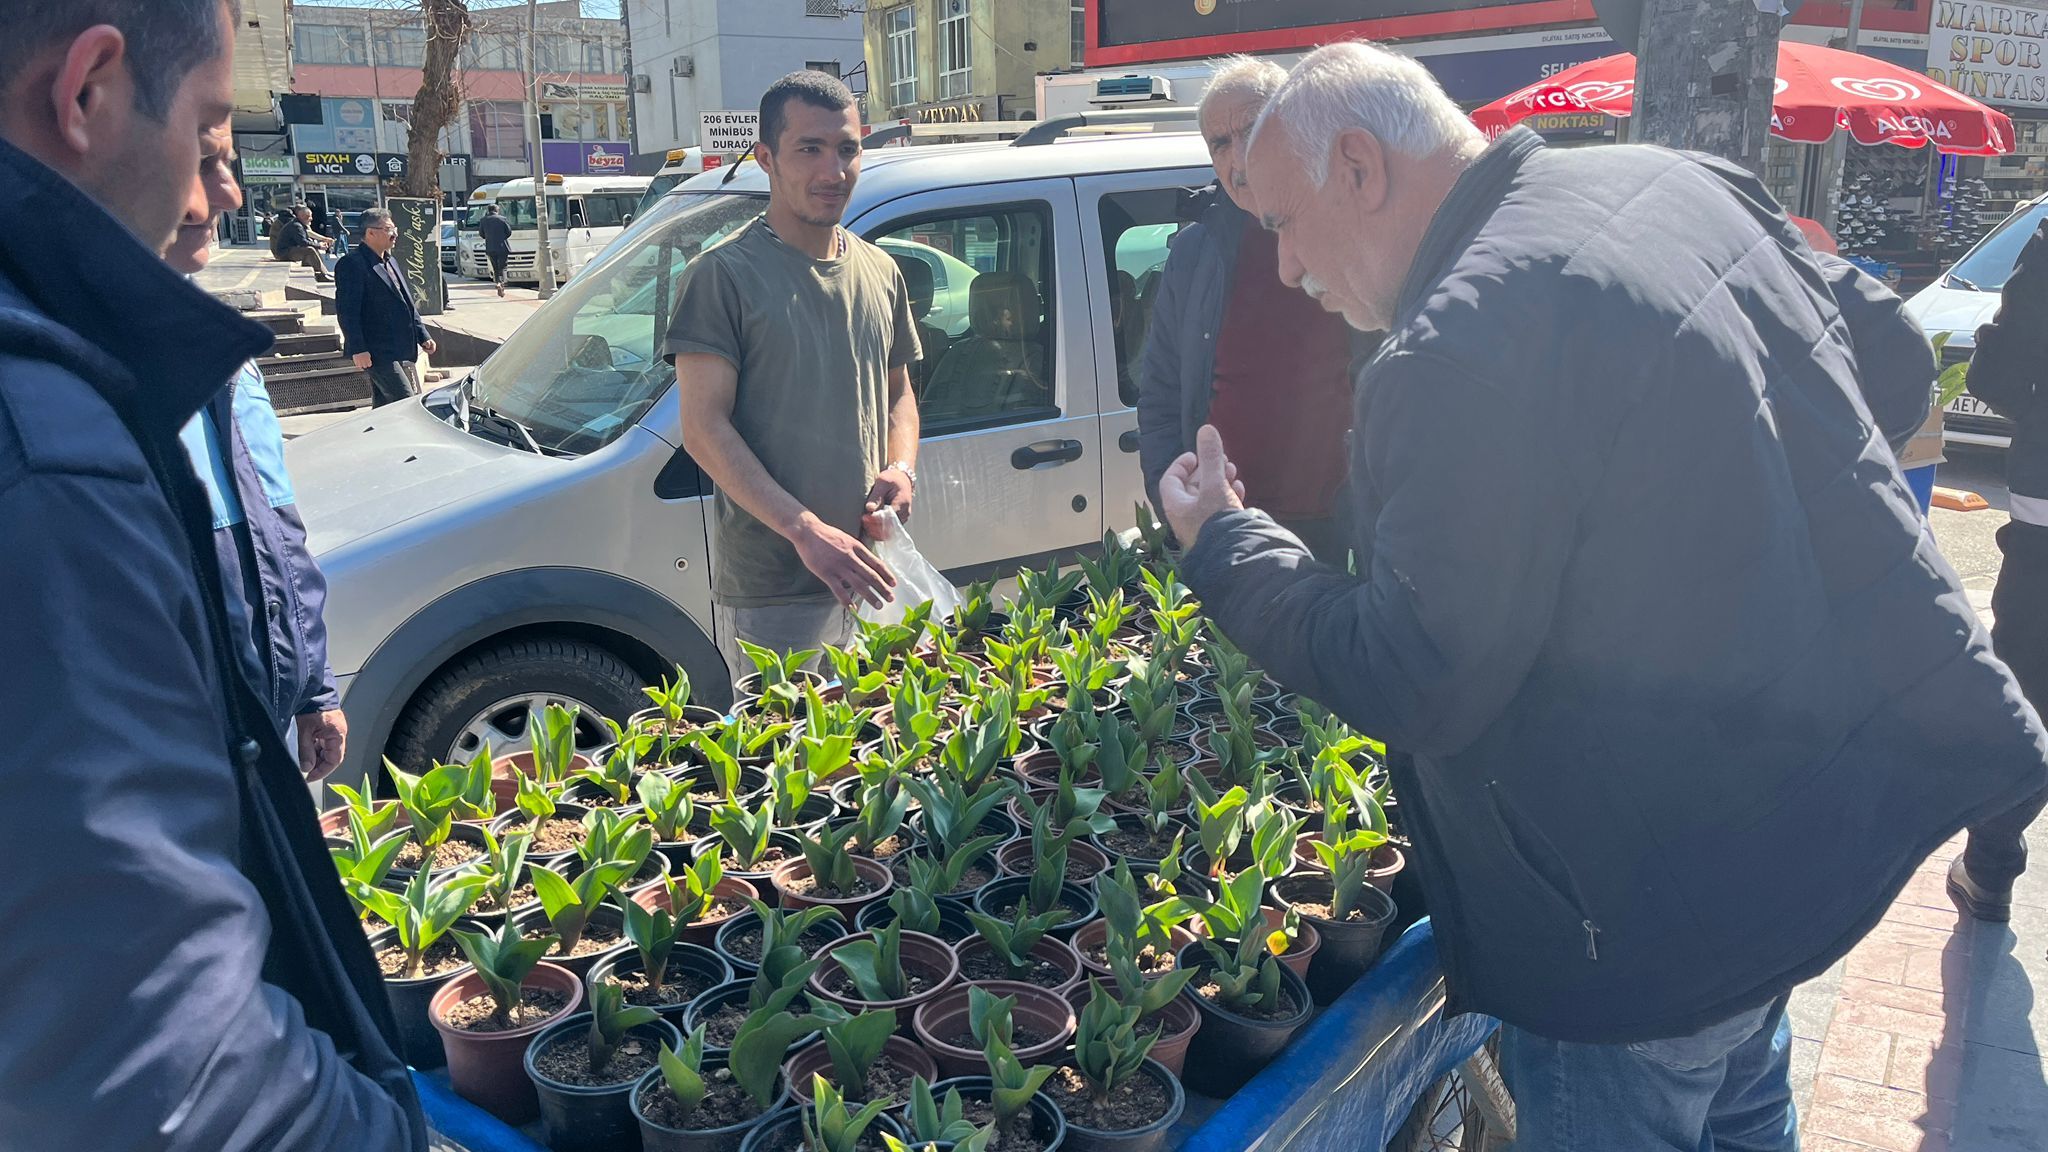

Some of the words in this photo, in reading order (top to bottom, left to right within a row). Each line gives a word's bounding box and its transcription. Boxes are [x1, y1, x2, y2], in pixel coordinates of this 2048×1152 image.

[1935, 1, 2048, 39] MARK
[1950, 34, 2041, 69] SPOR
[1927, 63, 2048, 102] DÜNYAS
[703, 115, 722, 124] 206
[724, 115, 758, 124] EVLER
[1537, 114, 1604, 129] NOKTASI
[709, 126, 754, 137] MİNİBÜS
[589, 155, 623, 167] beyza
[1951, 397, 1980, 413] AEY
